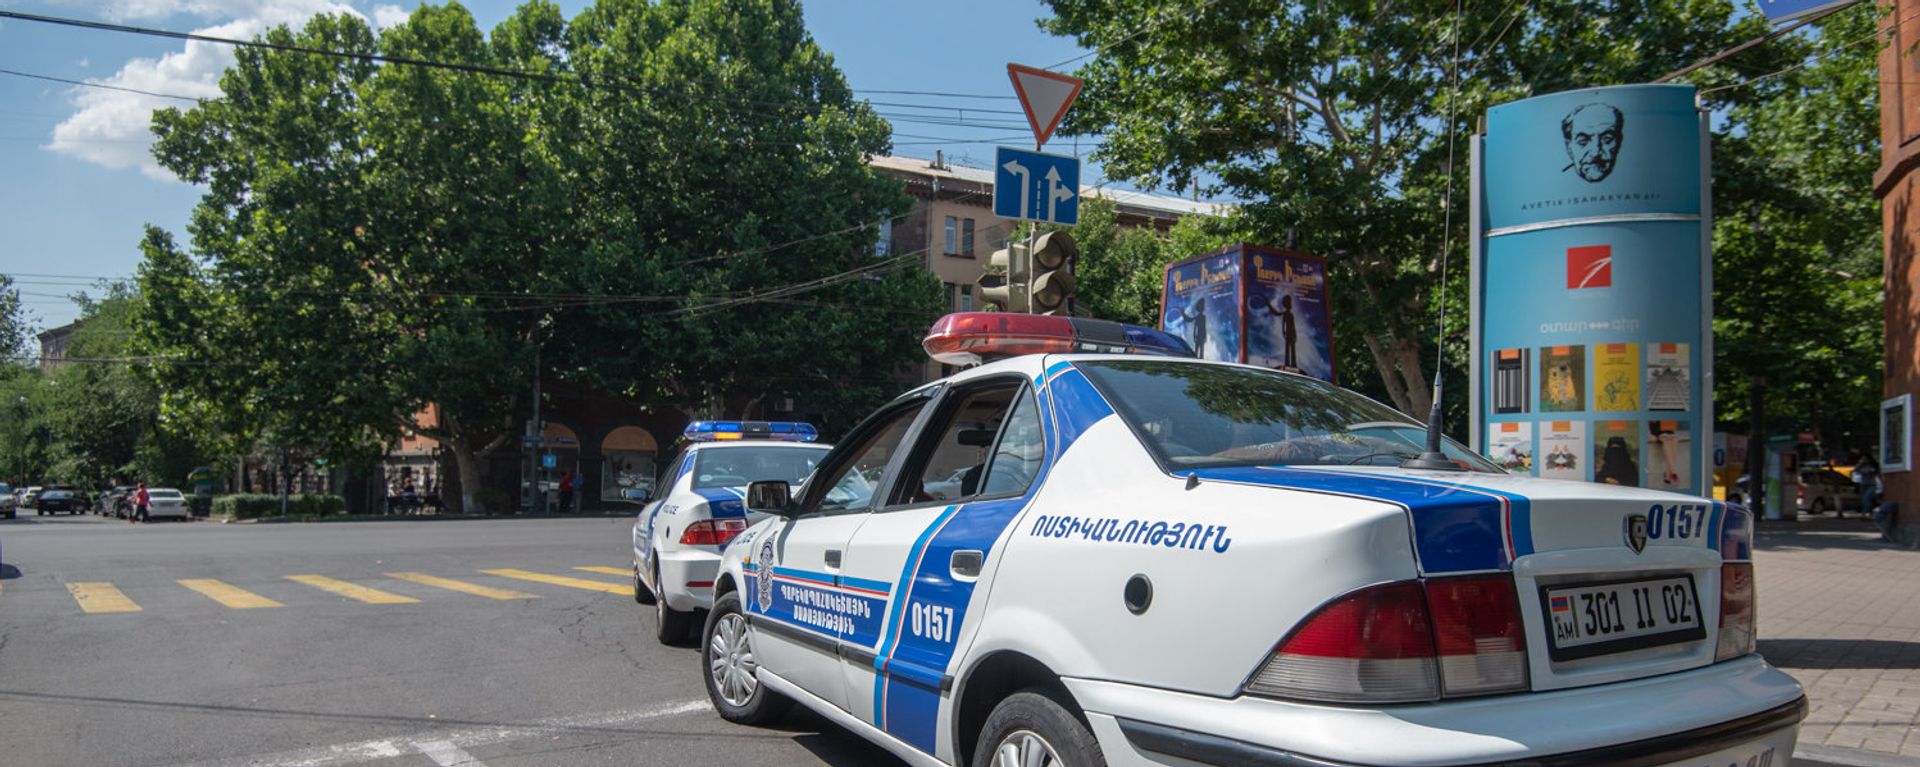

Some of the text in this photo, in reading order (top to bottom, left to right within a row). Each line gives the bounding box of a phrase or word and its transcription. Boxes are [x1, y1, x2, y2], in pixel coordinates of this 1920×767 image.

[1030, 514, 1232, 554] ՈՍՏԻԿԱՆՈՒԹՅՈՒՆ
[1647, 503, 1706, 540] 0157
[911, 601, 954, 643] 0157
[1580, 590, 1625, 637] 301
[1662, 583, 1692, 625] 02
[1555, 619, 1574, 642] AM
